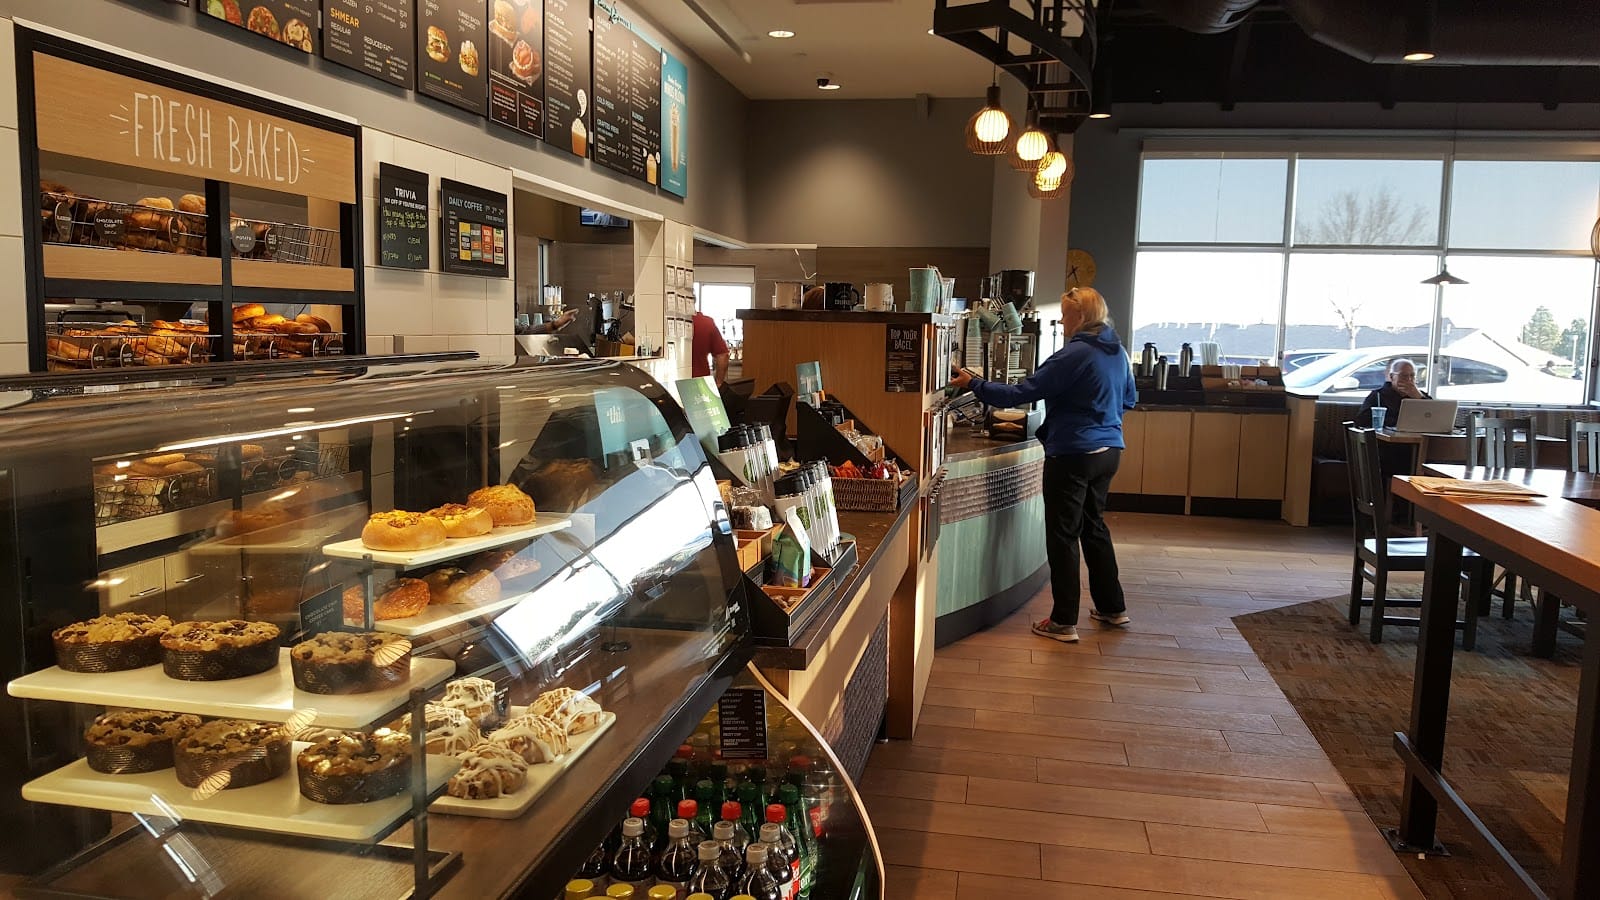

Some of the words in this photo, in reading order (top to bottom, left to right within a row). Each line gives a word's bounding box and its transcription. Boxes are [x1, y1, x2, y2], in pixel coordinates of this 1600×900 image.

[330, 8, 360, 28] SHMEAR
[330, 21, 352, 35] REGULAR
[363, 36, 383, 50] REDUCED
[134, 92, 212, 169] FRESH
[227, 115, 300, 185] BAKED
[394, 187, 417, 201] TRIVIA
[448, 196, 463, 207] DAILY
[463, 200, 483, 212] COFFEE
[890, 329, 901, 340] TOP
[902, 329, 918, 340] YOUR
[894, 339, 913, 350] BAGEL
